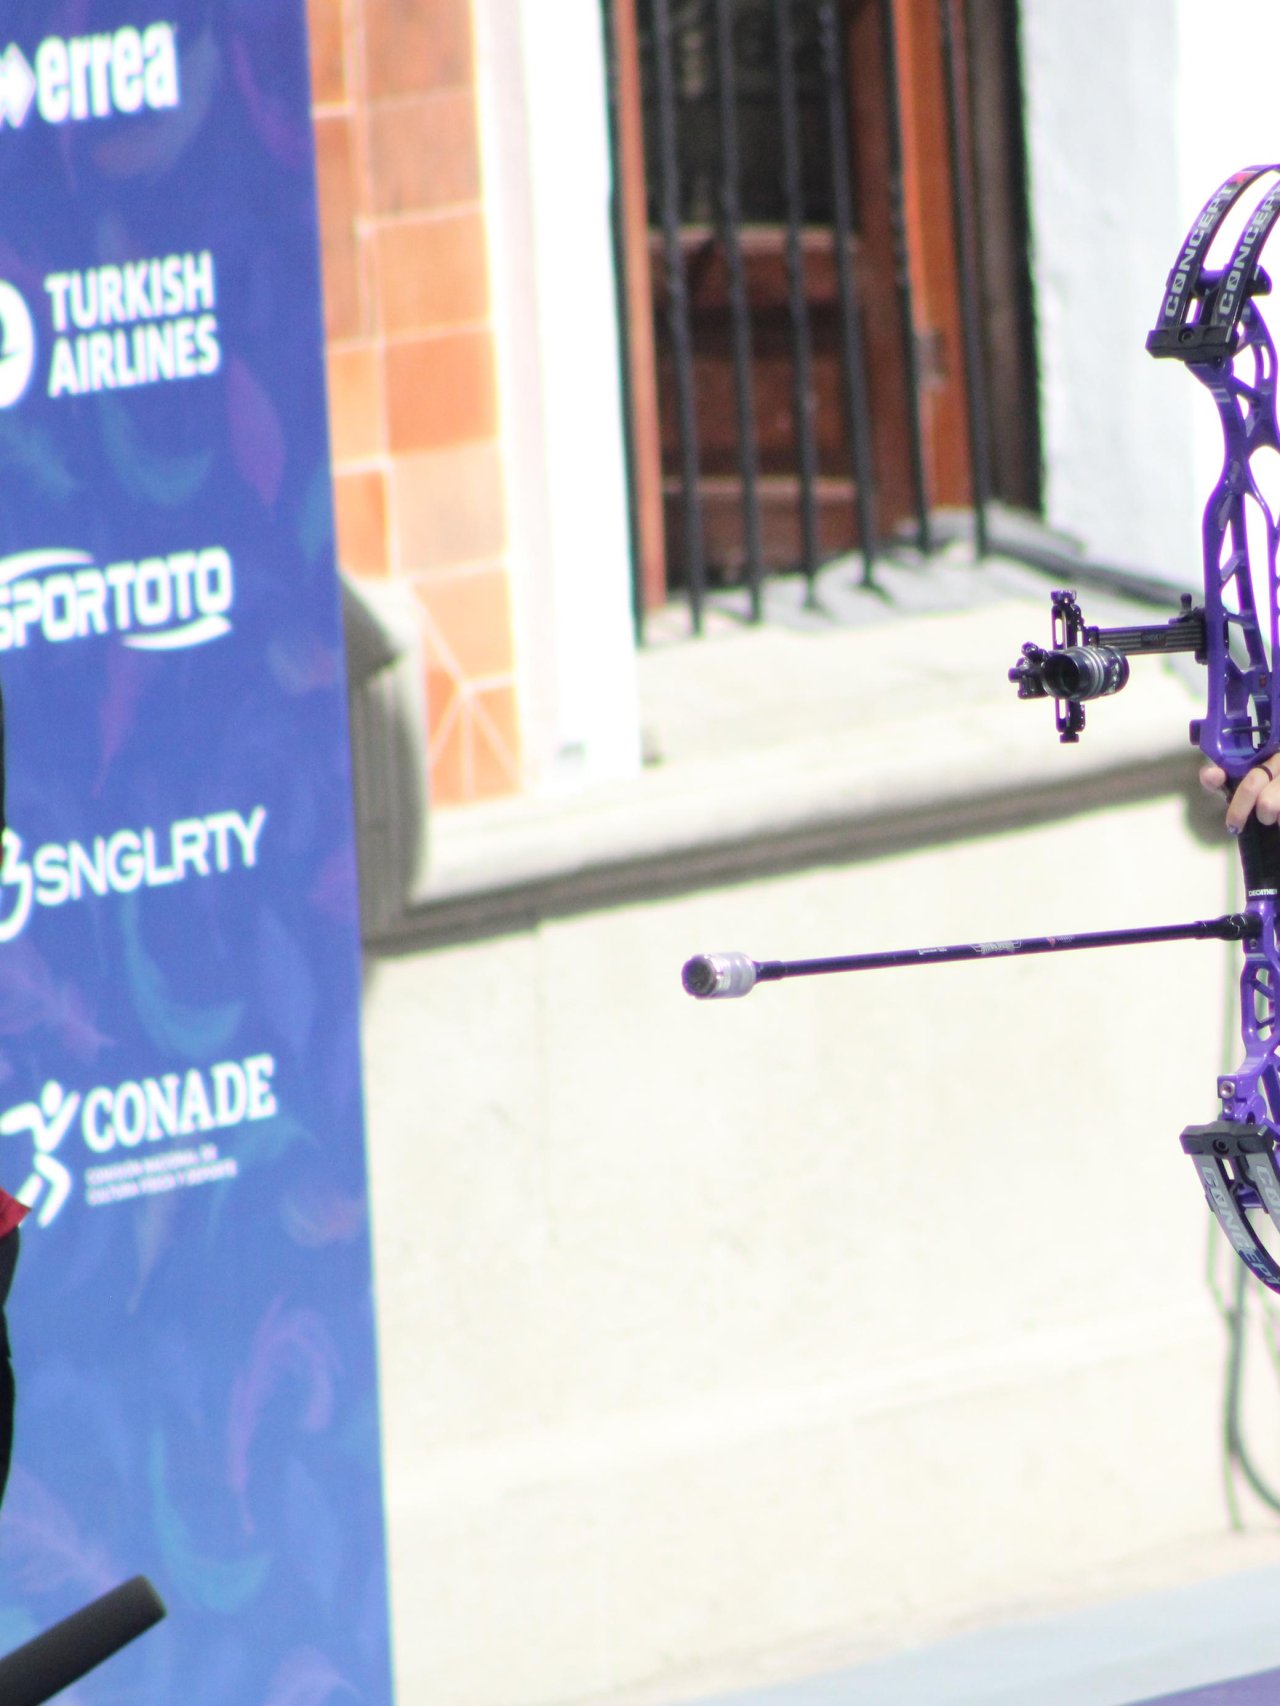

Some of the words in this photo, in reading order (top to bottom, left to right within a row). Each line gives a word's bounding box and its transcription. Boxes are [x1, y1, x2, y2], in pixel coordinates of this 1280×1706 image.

[44, 249, 216, 333] TURKISH
[48, 313, 222, 398] AIRLINES
[34, 806, 267, 907] SNGLRTY
[81, 1053, 278, 1153] CONADE
